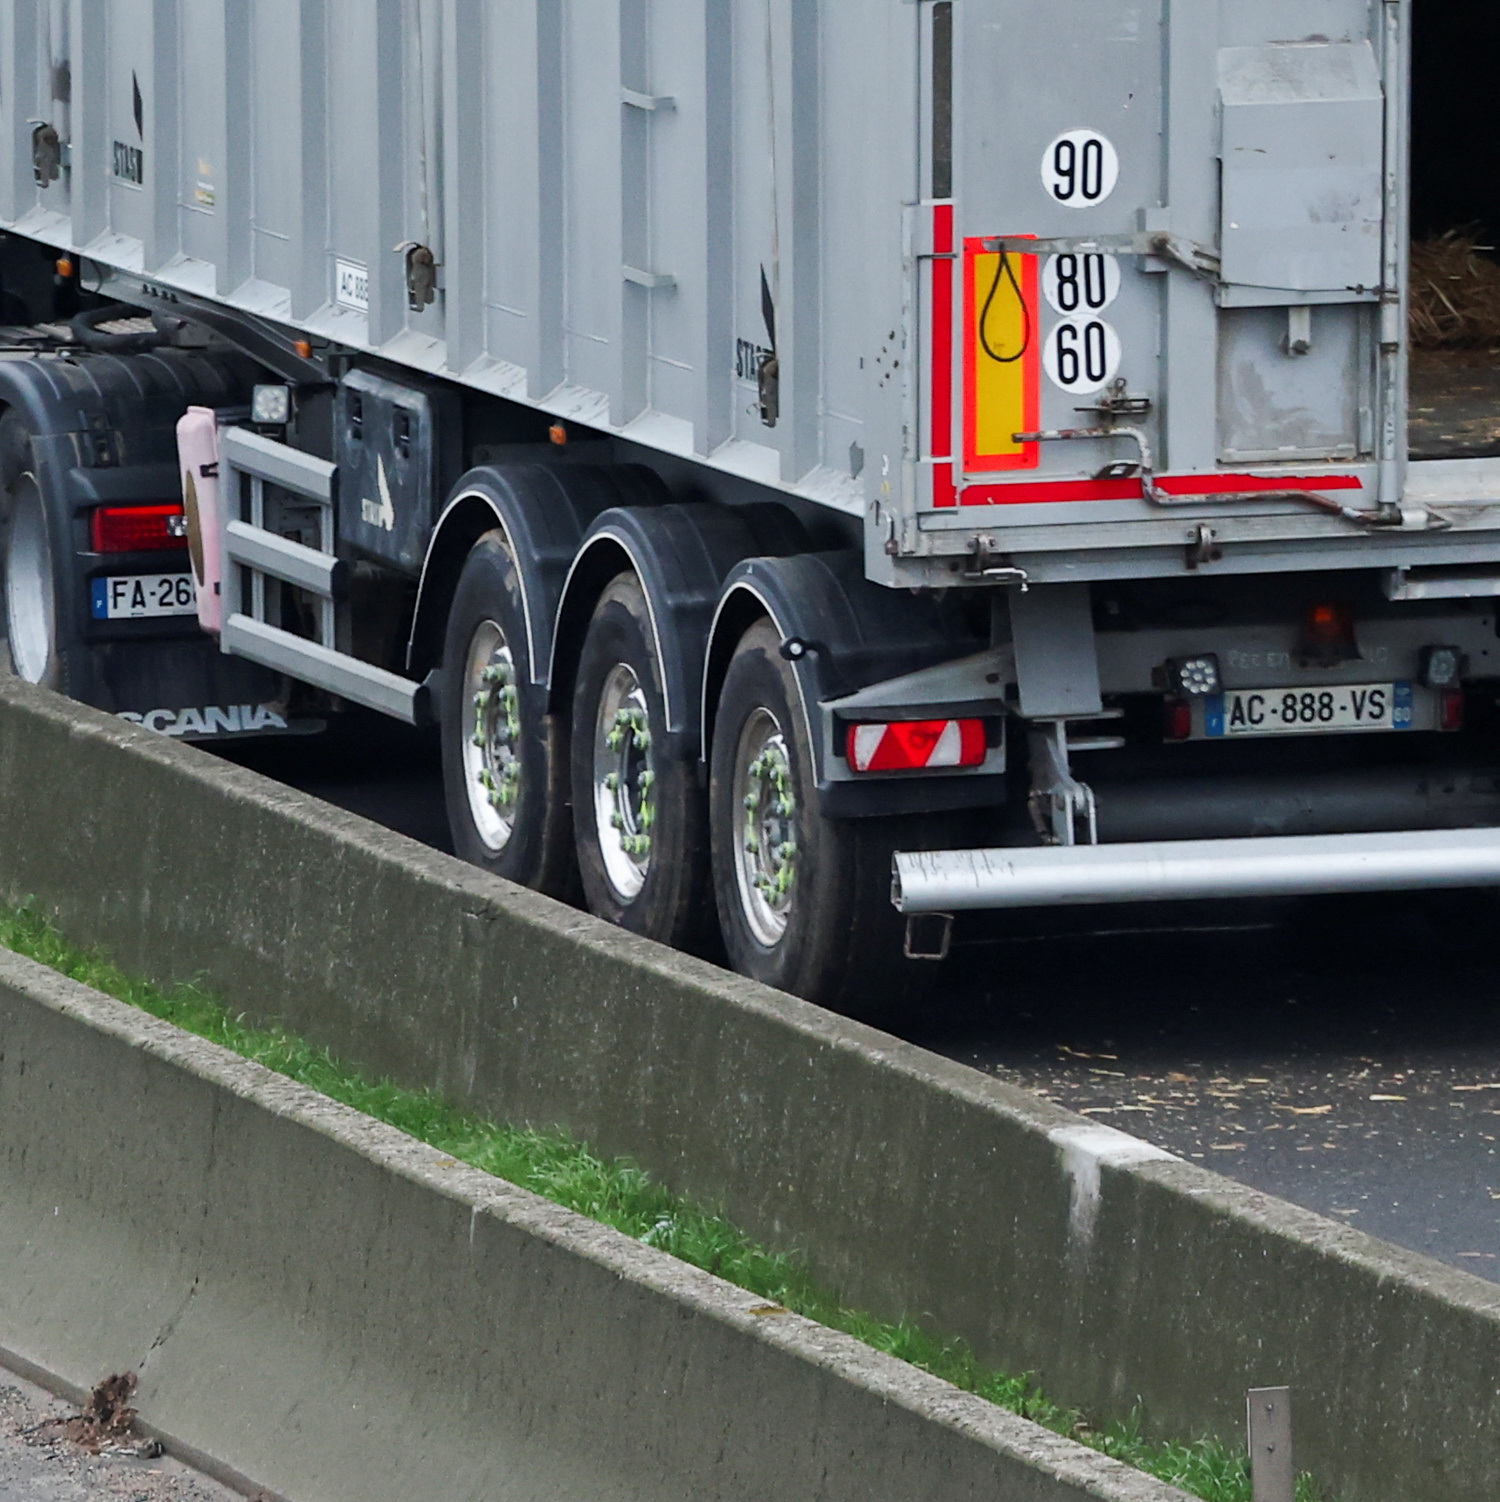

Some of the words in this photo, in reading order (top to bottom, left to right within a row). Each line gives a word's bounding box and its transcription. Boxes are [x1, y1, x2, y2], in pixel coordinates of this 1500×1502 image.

[1053, 139, 1102, 200] 90
[1056, 253, 1105, 312] 80
[1057, 321, 1106, 385] 60
[112, 577, 197, 610] FA-26
[1230, 690, 1386, 726] AC-888-VS
